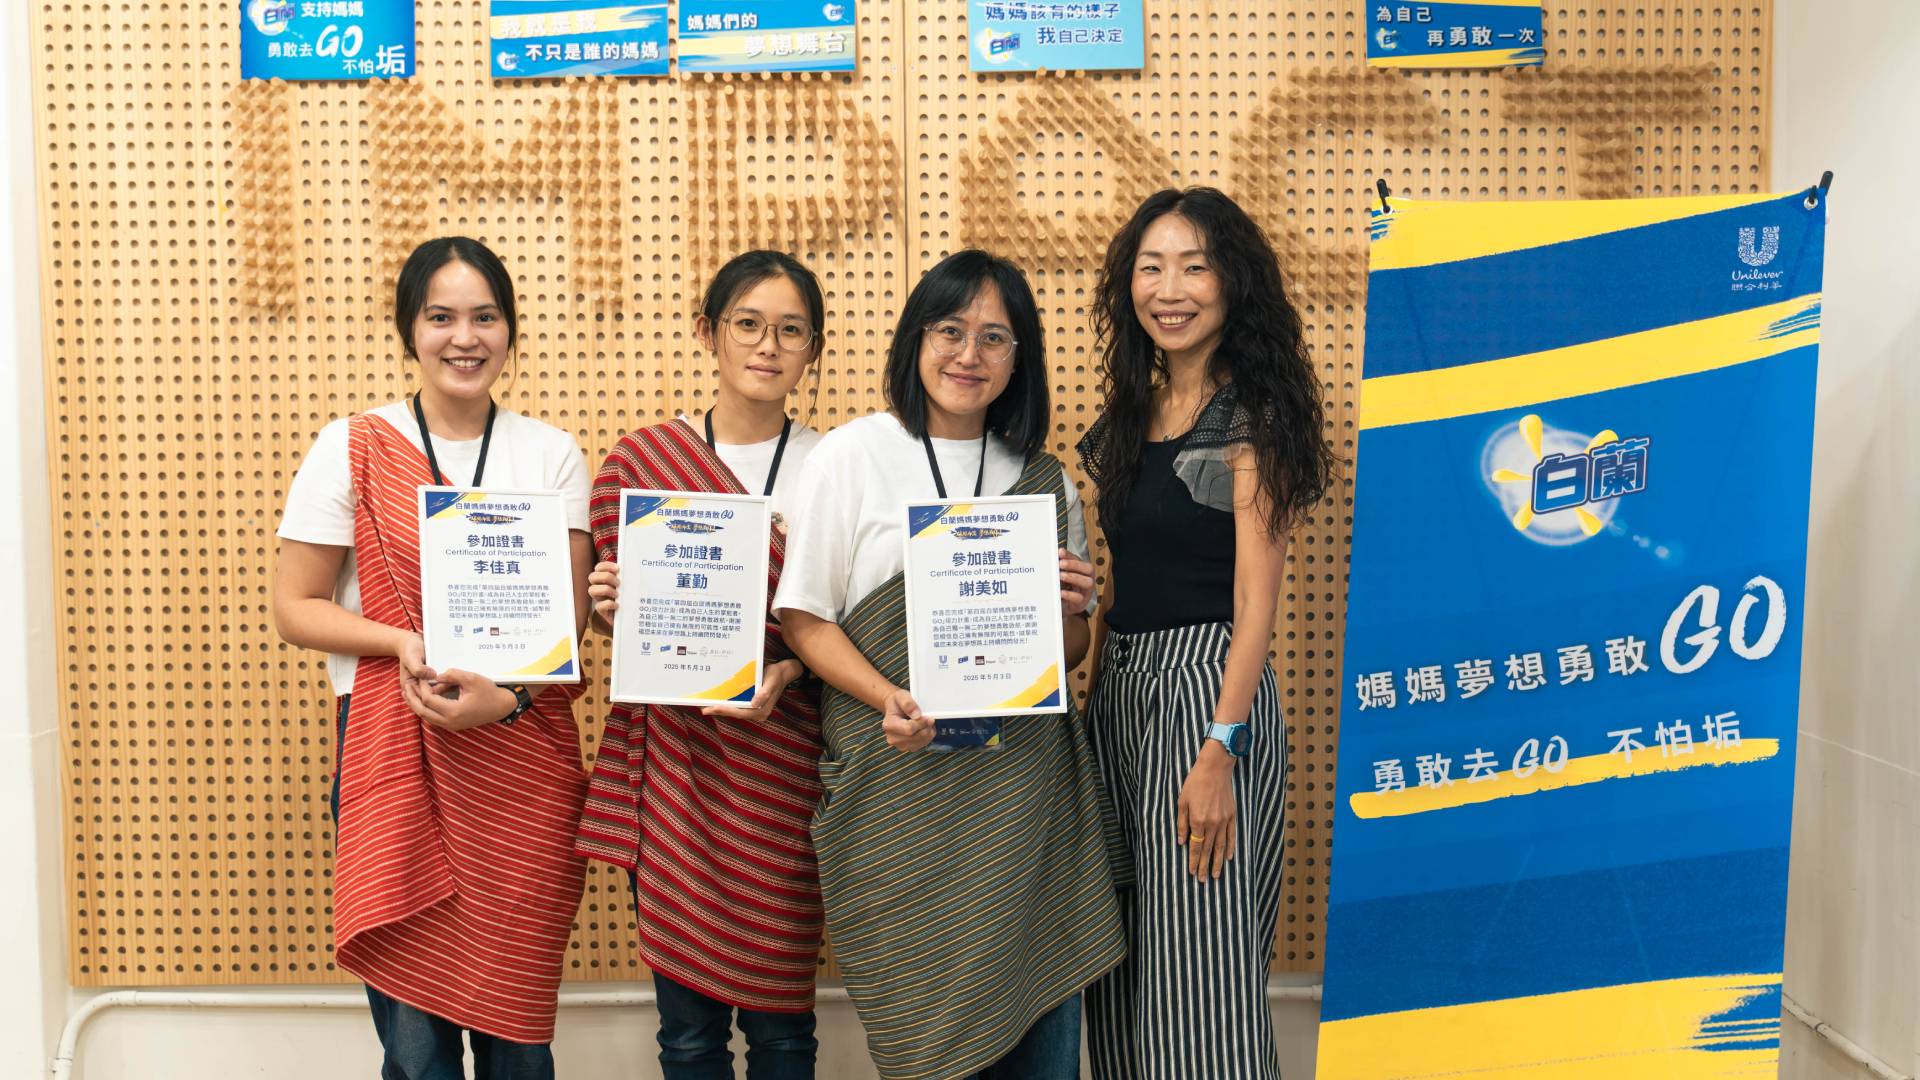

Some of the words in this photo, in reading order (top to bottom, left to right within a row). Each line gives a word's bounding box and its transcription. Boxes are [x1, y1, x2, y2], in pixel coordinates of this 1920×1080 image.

[301, 1, 364, 18] 支持媽媽
[1376, 6, 1432, 22] 為自己
[687, 12, 758, 31] 媽媽們的
[1038, 27, 1123, 44] 我自己決定
[1427, 26, 1535, 47] 再勇敢一次
[525, 41, 659, 61] 不只是誰的媽媽
[745, 31, 847, 59] 夢想舞台
[343, 44, 406, 75] 不怕垢
[1731, 268, 1784, 281] Unilever
[1531, 437, 1652, 515] 白蘭
[467, 534, 525, 549] 參加證書
[445, 549, 487, 557] Certificate
[488, 549, 497, 557] of
[497, 549, 547, 559] Participation
[664, 543, 723, 561] 參加證書
[952, 550, 1012, 567] 參加證書
[473, 560, 521, 575] 李佳真
[641, 559, 683, 568] Certificate
[684, 561, 692, 569] of
[693, 562, 743, 571] Participation
[929, 568, 973, 579] Certificate
[974, 568, 982, 576] of
[983, 566, 1035, 577] Participation
[676, 572, 708, 590] 董勤
[959, 579, 1008, 597] 謝美如
[1606, 711, 1741, 764] 不怕垢
